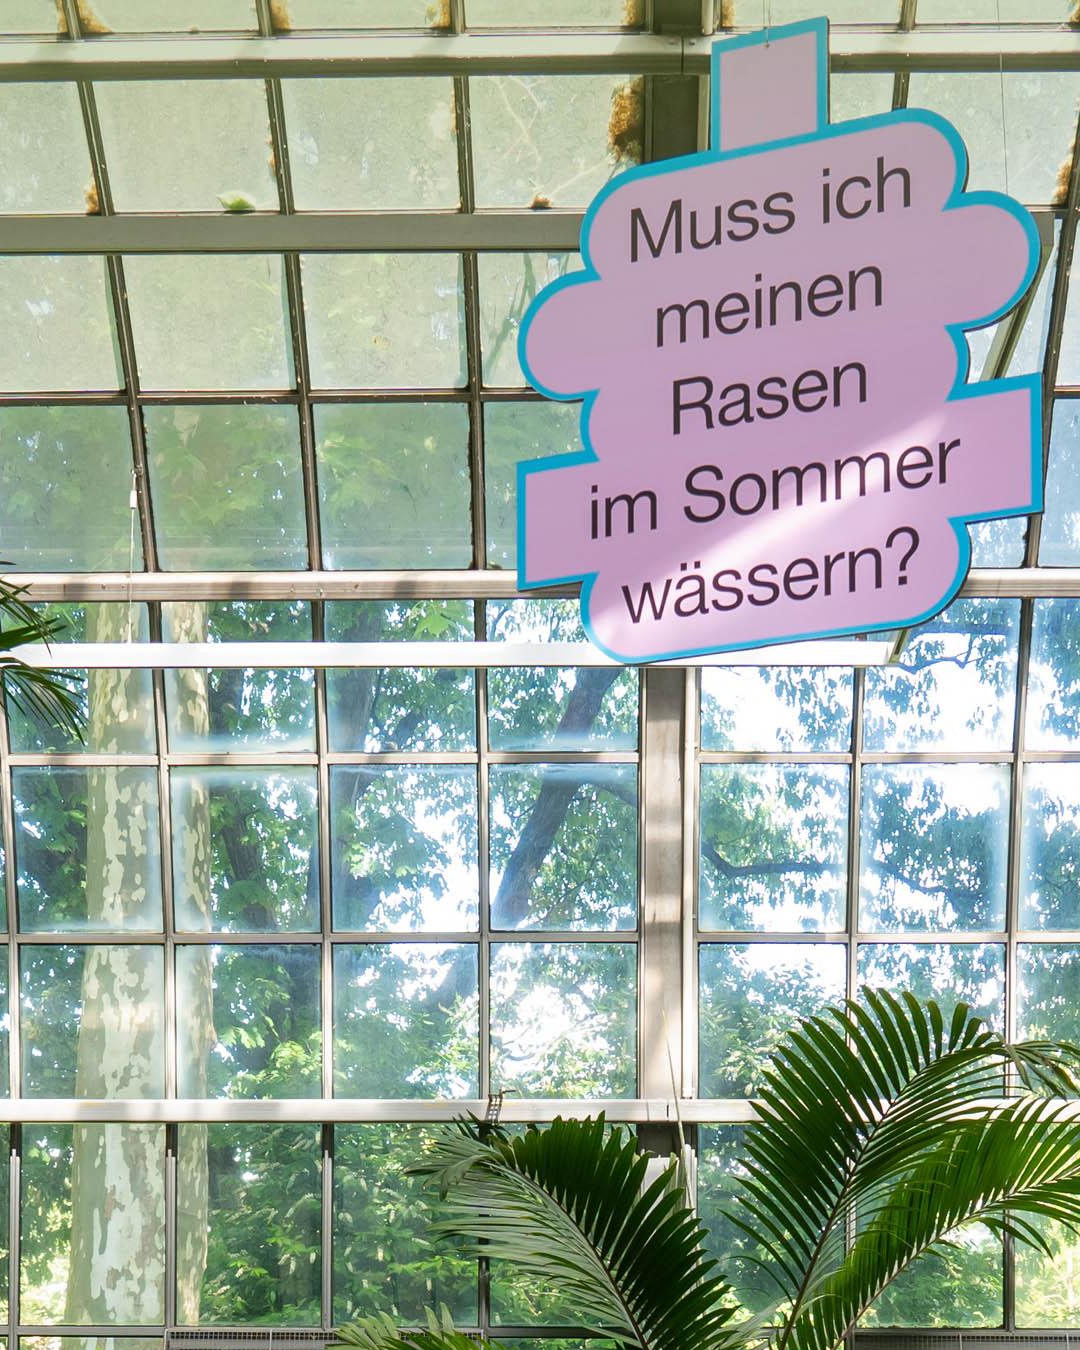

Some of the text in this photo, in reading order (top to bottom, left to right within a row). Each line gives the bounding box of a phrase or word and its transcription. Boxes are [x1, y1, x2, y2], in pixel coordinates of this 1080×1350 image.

[629, 156, 911, 263] Muss ich
[655, 263, 883, 348] meinen
[672, 361, 867, 435] Rasen
[590, 438, 961, 540] im Sommer
[622, 526, 920, 625] wässern?
